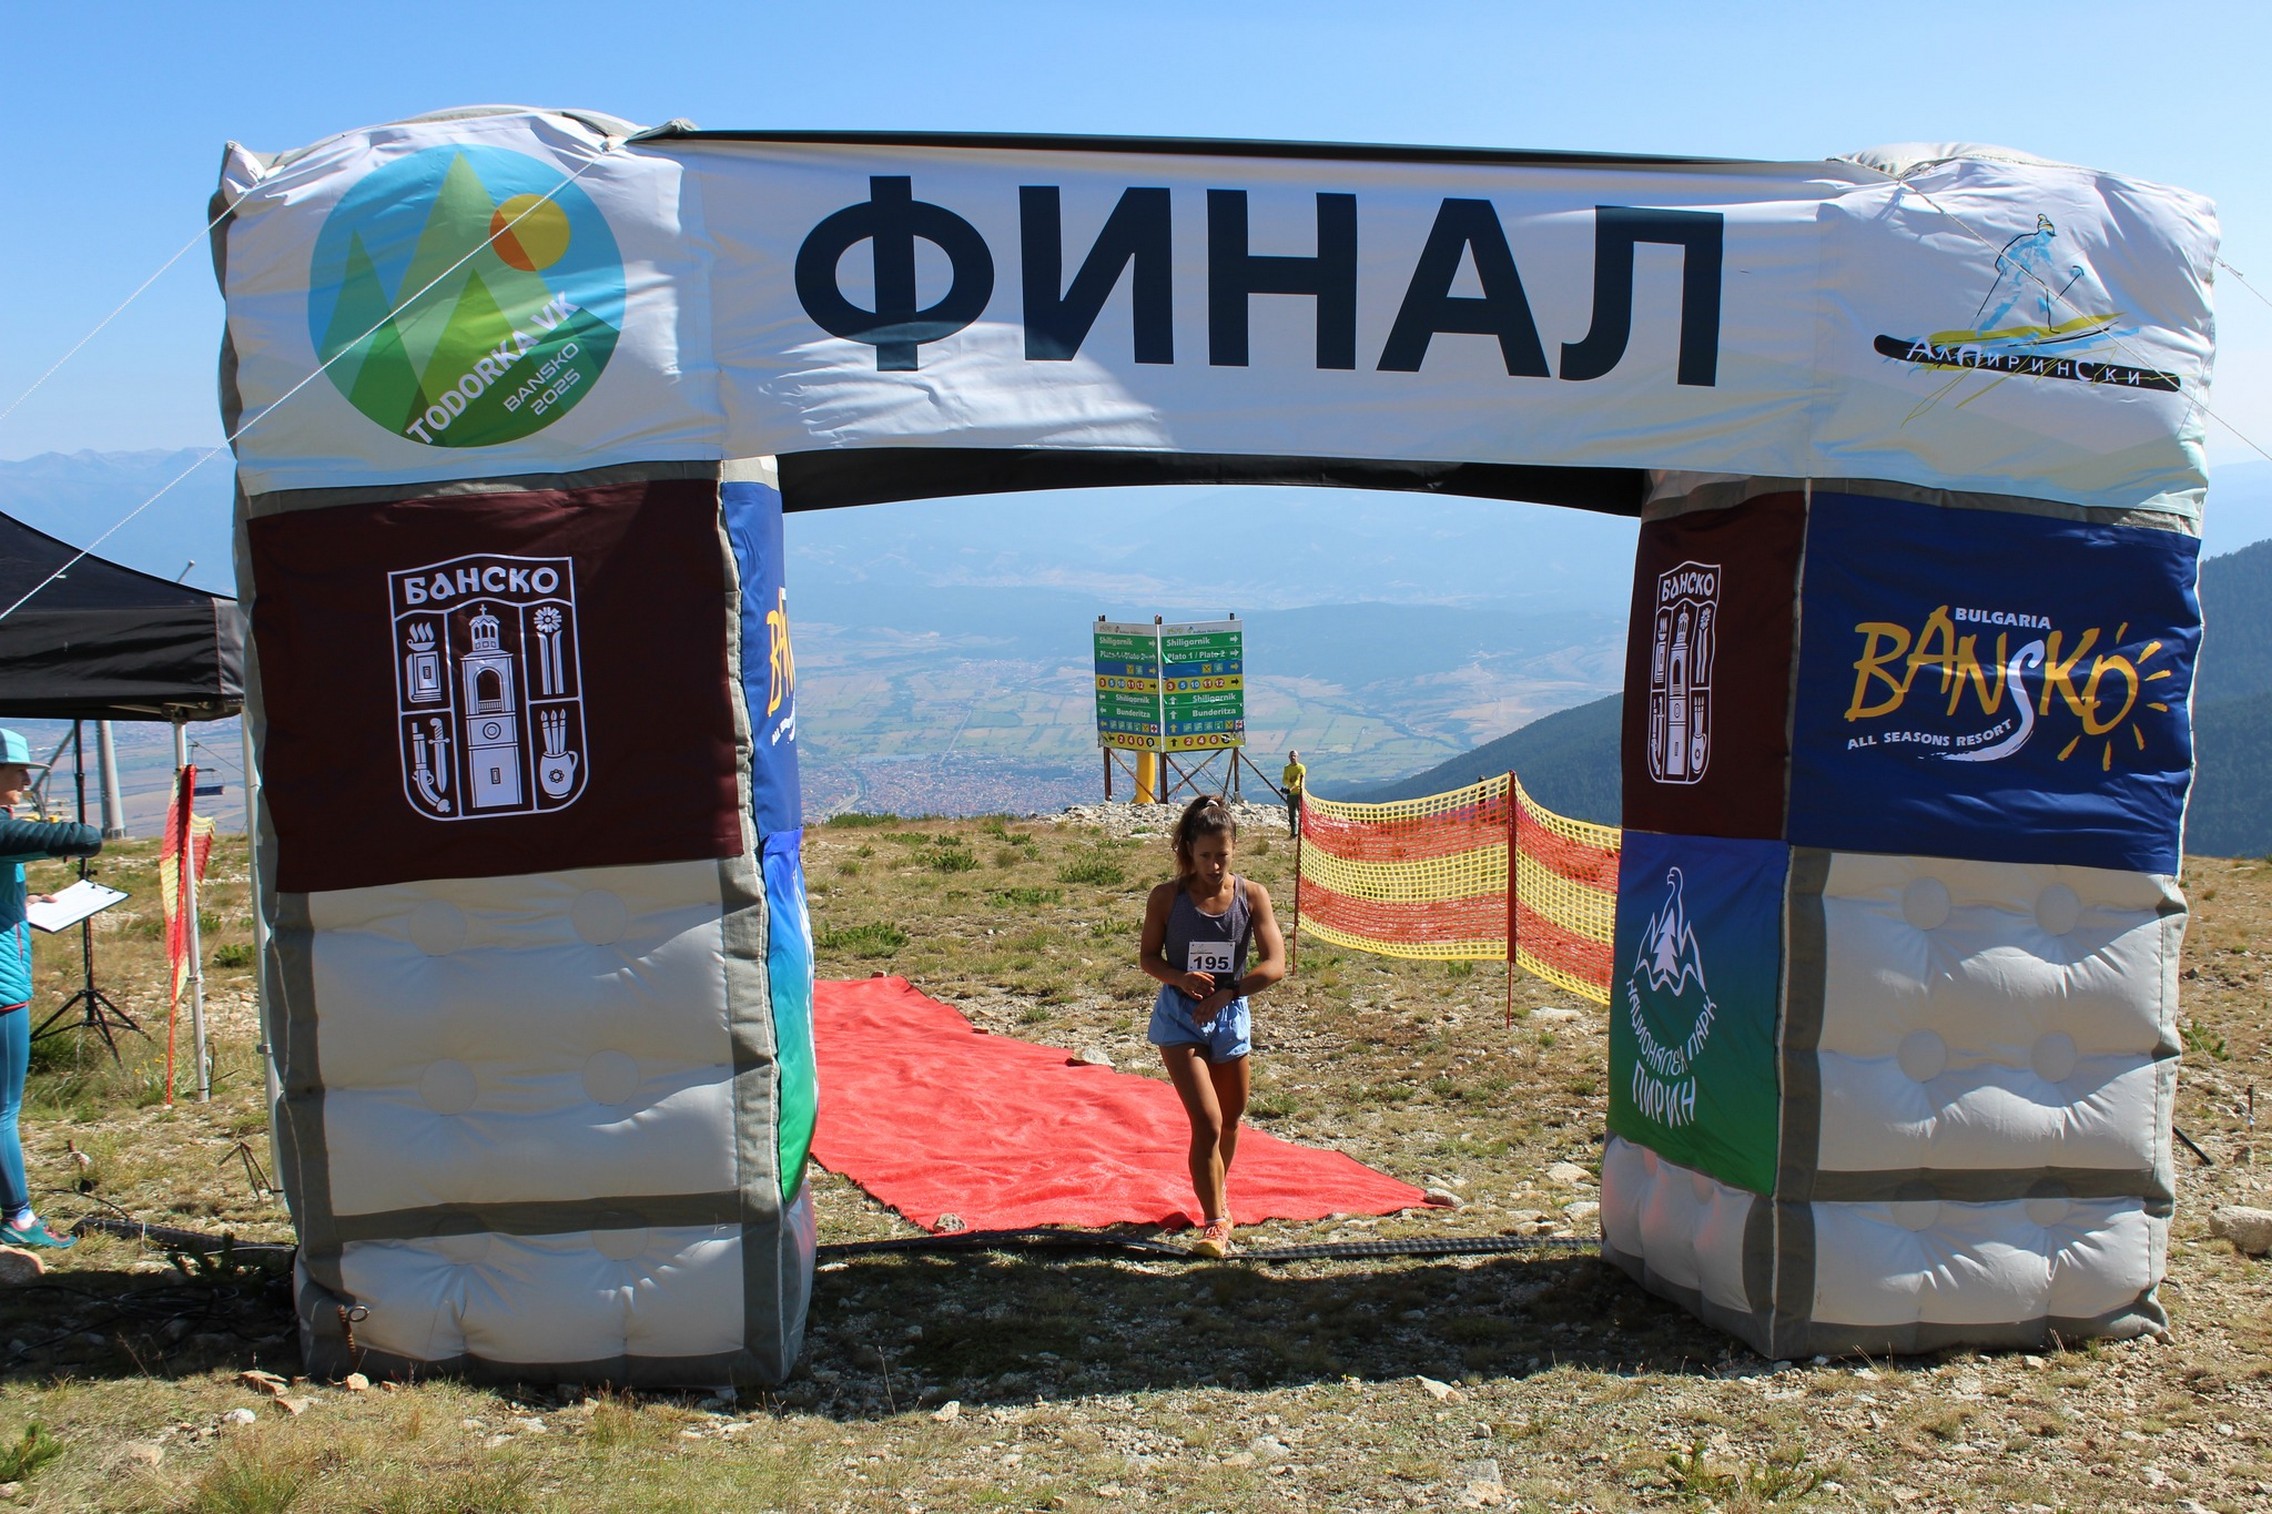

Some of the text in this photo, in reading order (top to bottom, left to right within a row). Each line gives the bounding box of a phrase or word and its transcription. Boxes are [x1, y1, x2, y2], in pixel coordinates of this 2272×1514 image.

[794, 175, 1725, 387] ФИНАЛ
[406, 291, 581, 445] TODORKA VK
[503, 342, 579, 412] BANSKO
[530, 368, 581, 416] 2025
[1166, 637, 1211, 647] Shiligornik
[1955, 607, 2051, 630] BULGARIA
[1844, 604, 2139, 761] BANSKO
[1116, 708, 1151, 718] Bunderitza
[1192, 708, 1236, 717] Bunderitza
[1847, 718, 2013, 750] ALL SEASONS RESORT
[1193, 956, 1229, 970] 195
[1626, 978, 1717, 1076] НАЦИОНАЛЕН ПАРК
[1632, 1059, 1697, 1130] ПИРИН
